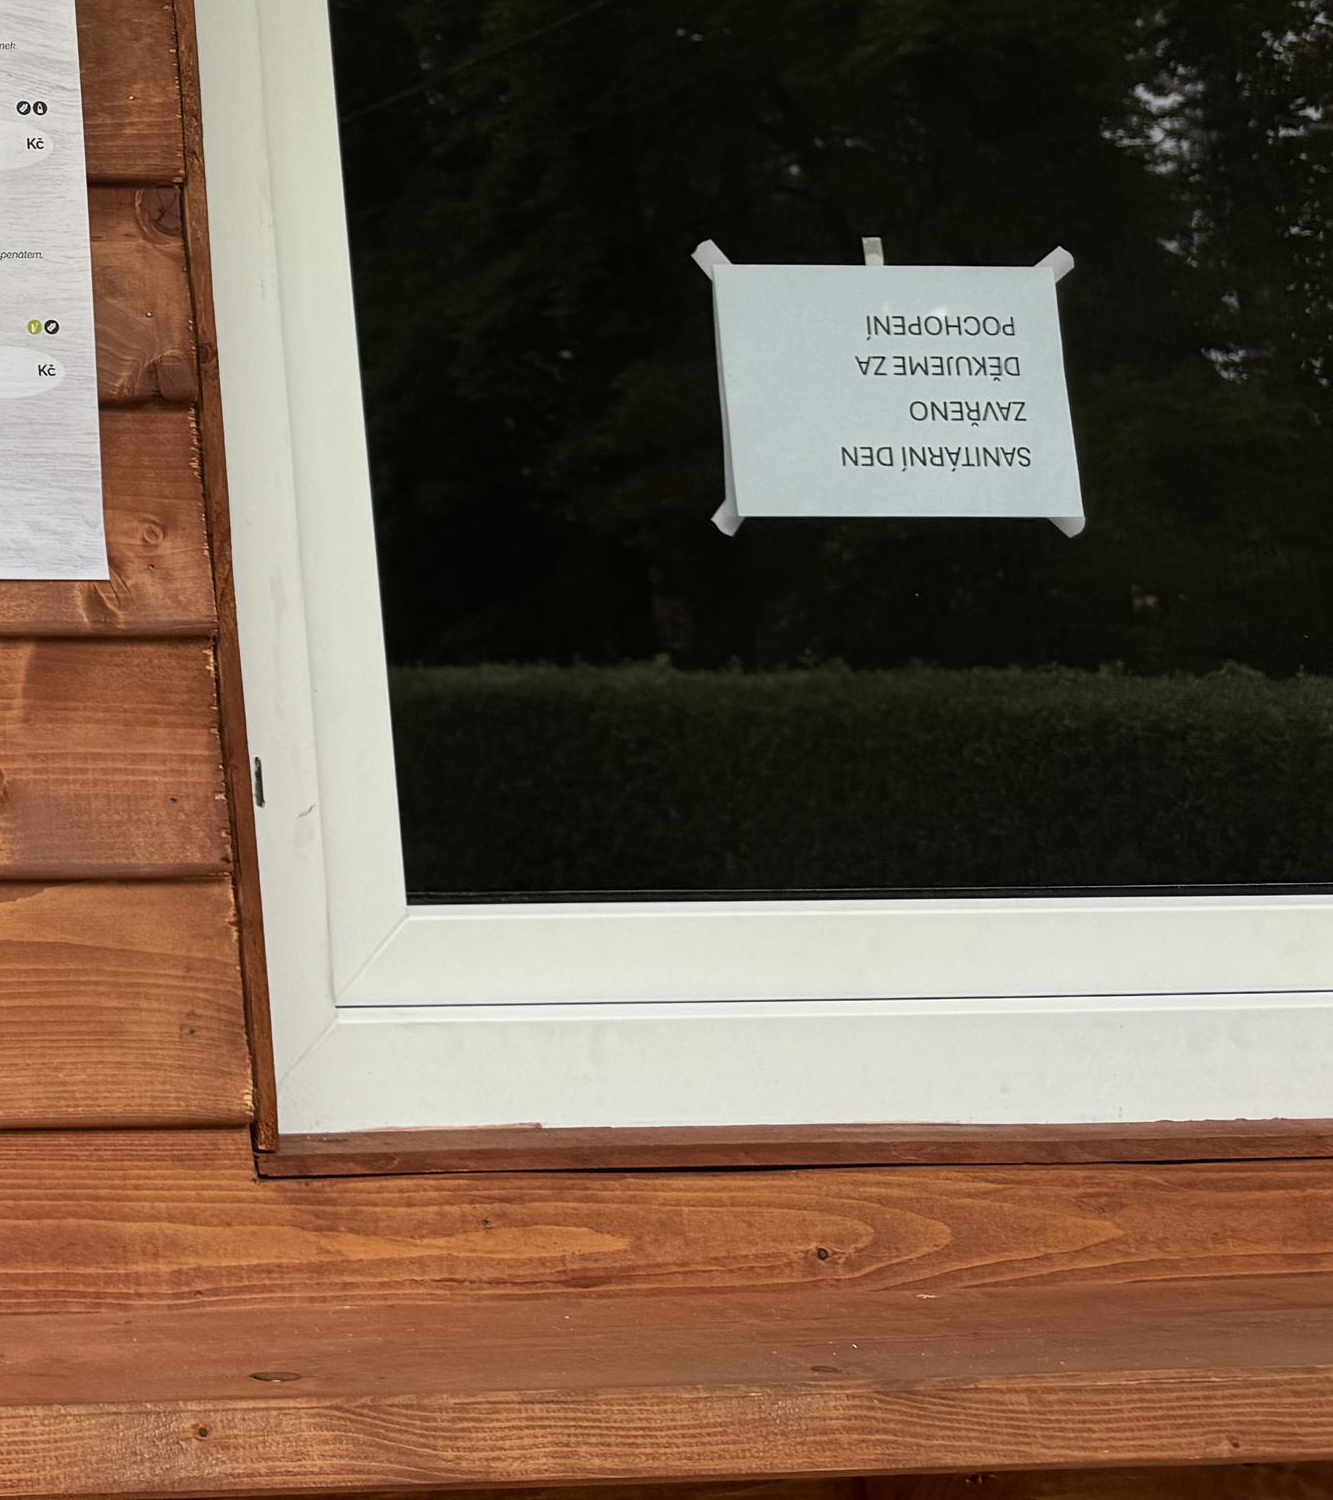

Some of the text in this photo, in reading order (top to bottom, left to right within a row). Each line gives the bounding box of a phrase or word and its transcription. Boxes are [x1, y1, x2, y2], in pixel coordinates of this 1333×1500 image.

[27, 137, 44, 150] Kč
[866, 315, 1015, 341] POCHOPENÍ
[38, 364, 56, 376] Kč
[855, 355, 1020, 381] DĚKUJEME ZA
[910, 401, 1027, 427] ZAVŘENO
[842, 446, 1031, 472] SANITÁRNÍ DEN
